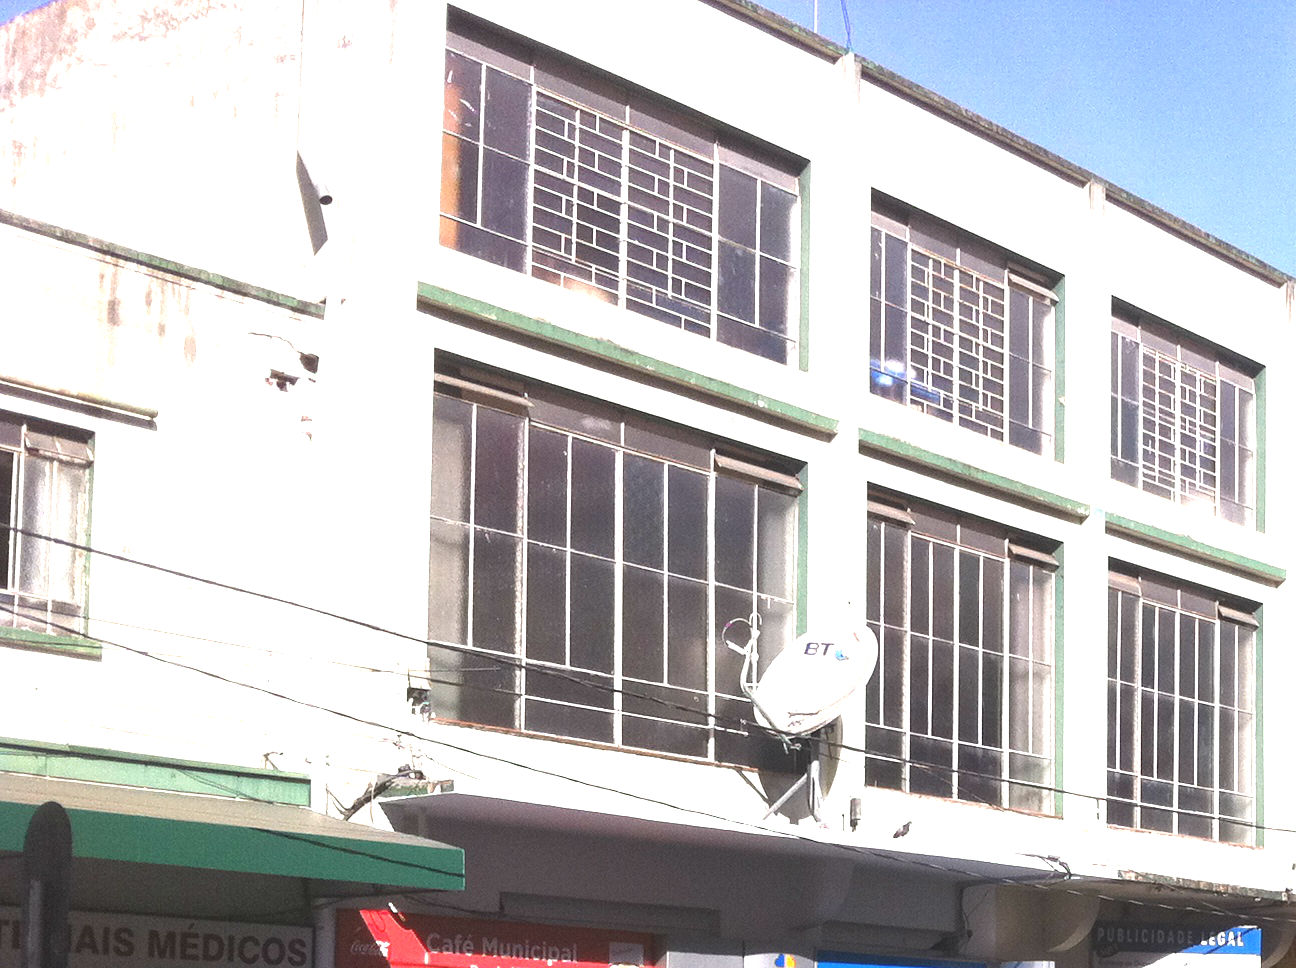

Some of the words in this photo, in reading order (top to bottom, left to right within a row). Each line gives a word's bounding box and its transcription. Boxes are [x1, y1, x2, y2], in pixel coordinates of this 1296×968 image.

[148, 922, 307, 967] MÉDICOS
[427, 933, 474, 957] Café
[482, 936, 578, 967] Municipal
[1096, 927, 1194, 946] PUBLICIDADE
[1200, 931, 1245, 947] LEGAL
